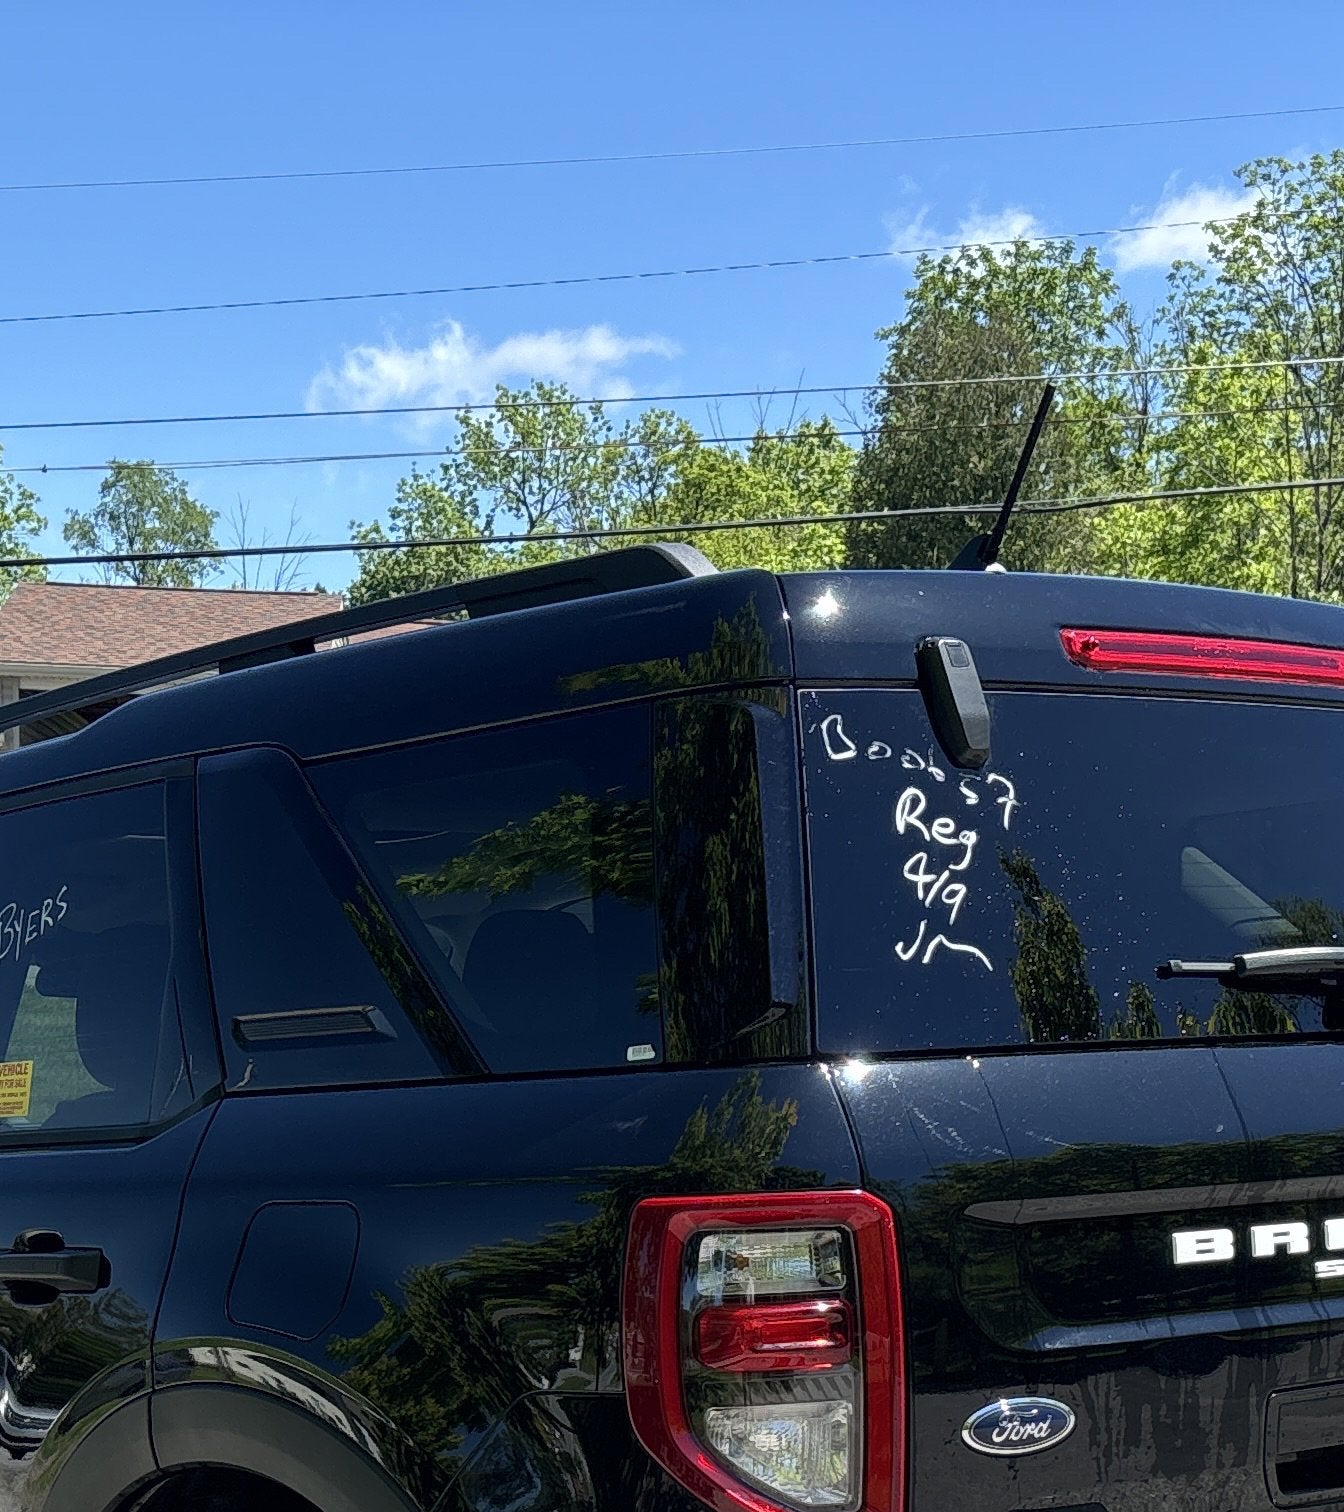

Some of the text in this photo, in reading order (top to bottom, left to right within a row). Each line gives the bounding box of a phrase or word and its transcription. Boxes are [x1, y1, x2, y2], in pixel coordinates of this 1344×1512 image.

[894, 786, 978, 870] Reg
[903, 851, 967, 926] 4/9
[991, 1409, 1053, 1443] Ford
